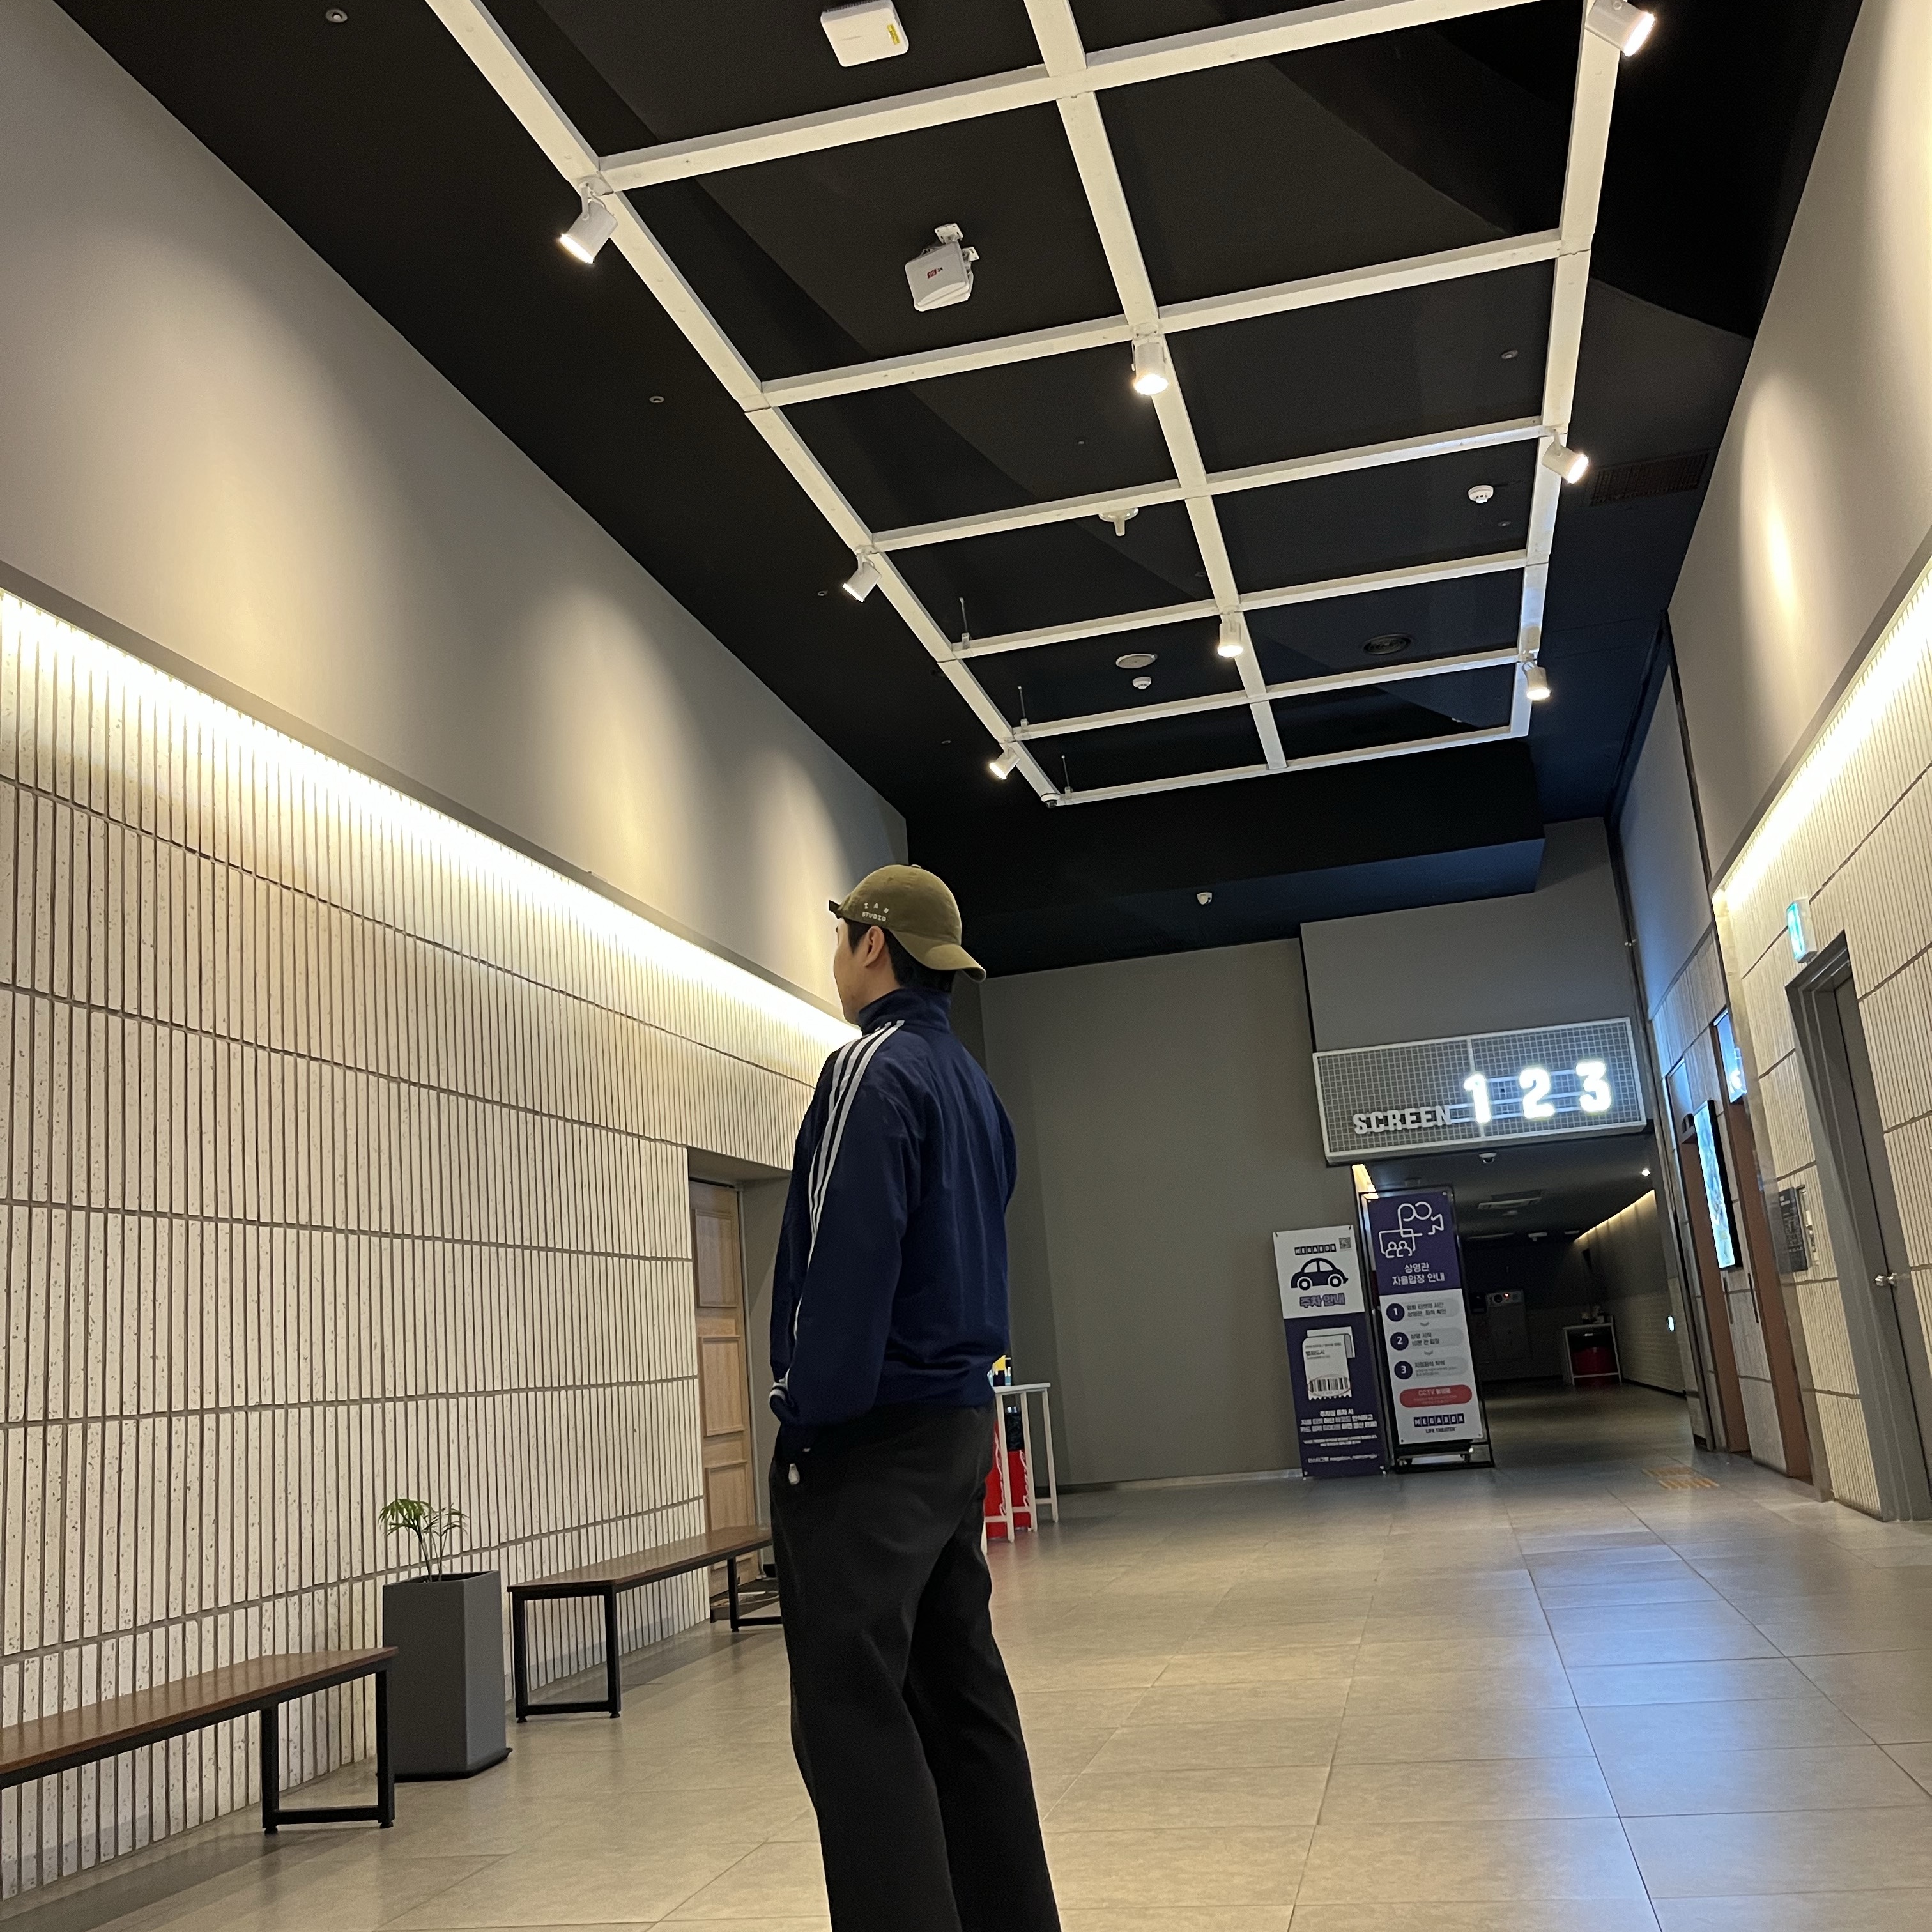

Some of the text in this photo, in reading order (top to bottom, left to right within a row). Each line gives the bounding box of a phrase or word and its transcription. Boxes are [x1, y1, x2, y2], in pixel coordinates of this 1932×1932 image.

[862, 912, 887, 922] STUDIO
[1353, 1059, 1613, 1134] SCREEN 1 2 3
[1404, 1262, 1429, 1273] 상영관
[1427, 1272, 1445, 1282] 안내
[1300, 1292, 1346, 1308] 주차 안내
[1393, 1307, 1398, 1316] 1
[1397, 1336, 1403, 1345] 2
[1400, 1365, 1407, 1374] 3
[1414, 1414, 1464, 1427] MEGABOX
